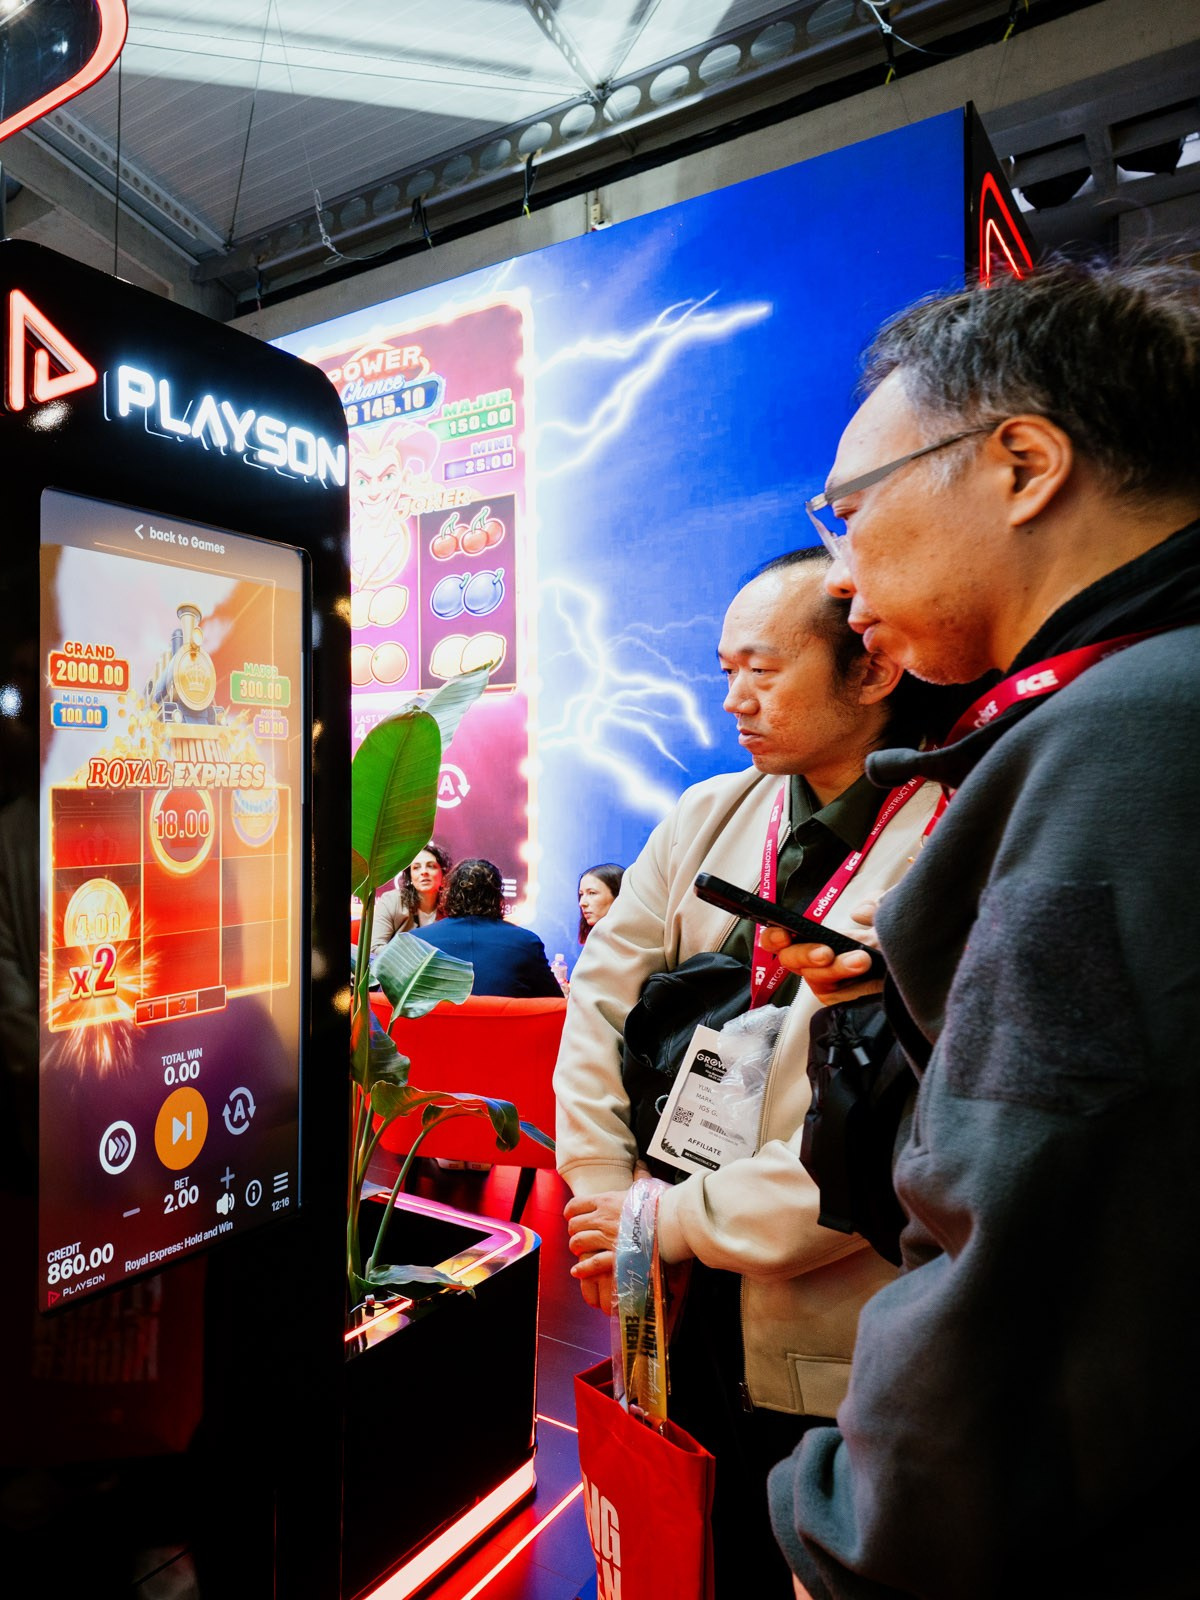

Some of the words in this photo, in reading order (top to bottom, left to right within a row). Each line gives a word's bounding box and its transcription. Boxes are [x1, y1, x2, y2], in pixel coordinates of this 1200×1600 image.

[361, 386, 426, 422] 145.10
[442, 389, 513, 418] MAJOR
[117, 365, 347, 487] PLAYSON
[450, 408, 512, 436] 150.00
[471, 435, 513, 455] MINI
[465, 453, 513, 475] 25.00
[149, 526, 176, 544] back
[178, 534, 189, 546] to
[191, 536, 225, 554] Games
[63, 641, 116, 660] GRAND
[56, 659, 124, 686] 2000.00
[1015, 669, 1059, 695] ICE
[62, 694, 99, 704] MINOR
[240, 679, 282, 700] 300.00
[60, 708, 102, 725] 100.00
[88, 758, 172, 788] ROYAL
[173, 761, 266, 789] EXPRESS
[153, 809, 211, 839] 18.00
[870, 785, 912, 837] BETCONSTRUCT
[844, 851, 863, 872] ICE
[75, 911, 121, 942] 4.00
[69, 943, 118, 1001] x2
[755, 966, 766, 986] ICE
[161, 1053, 186, 1067] TOTAL
[187, 1047, 203, 1060] WIN
[163, 1060, 201, 1086] 0.00
[687, 1137, 722, 1157] AFFILIATE
[174, 1176, 190, 1191] BET
[163, 1185, 200, 1215] 2.00
[271, 1196, 290, 1212] 12:16
[47, 1241, 82, 1264] CREDIT
[125, 1253, 149, 1273] Royal
[150, 1241, 184, 1262] Express:
[184, 1231, 203, 1249] Hold
[203, 1226, 218, 1240] and
[218, 1220, 234, 1234] Win
[47, 1242, 114, 1285] 860.00
[62, 1273, 106, 1297] PLAYSON
